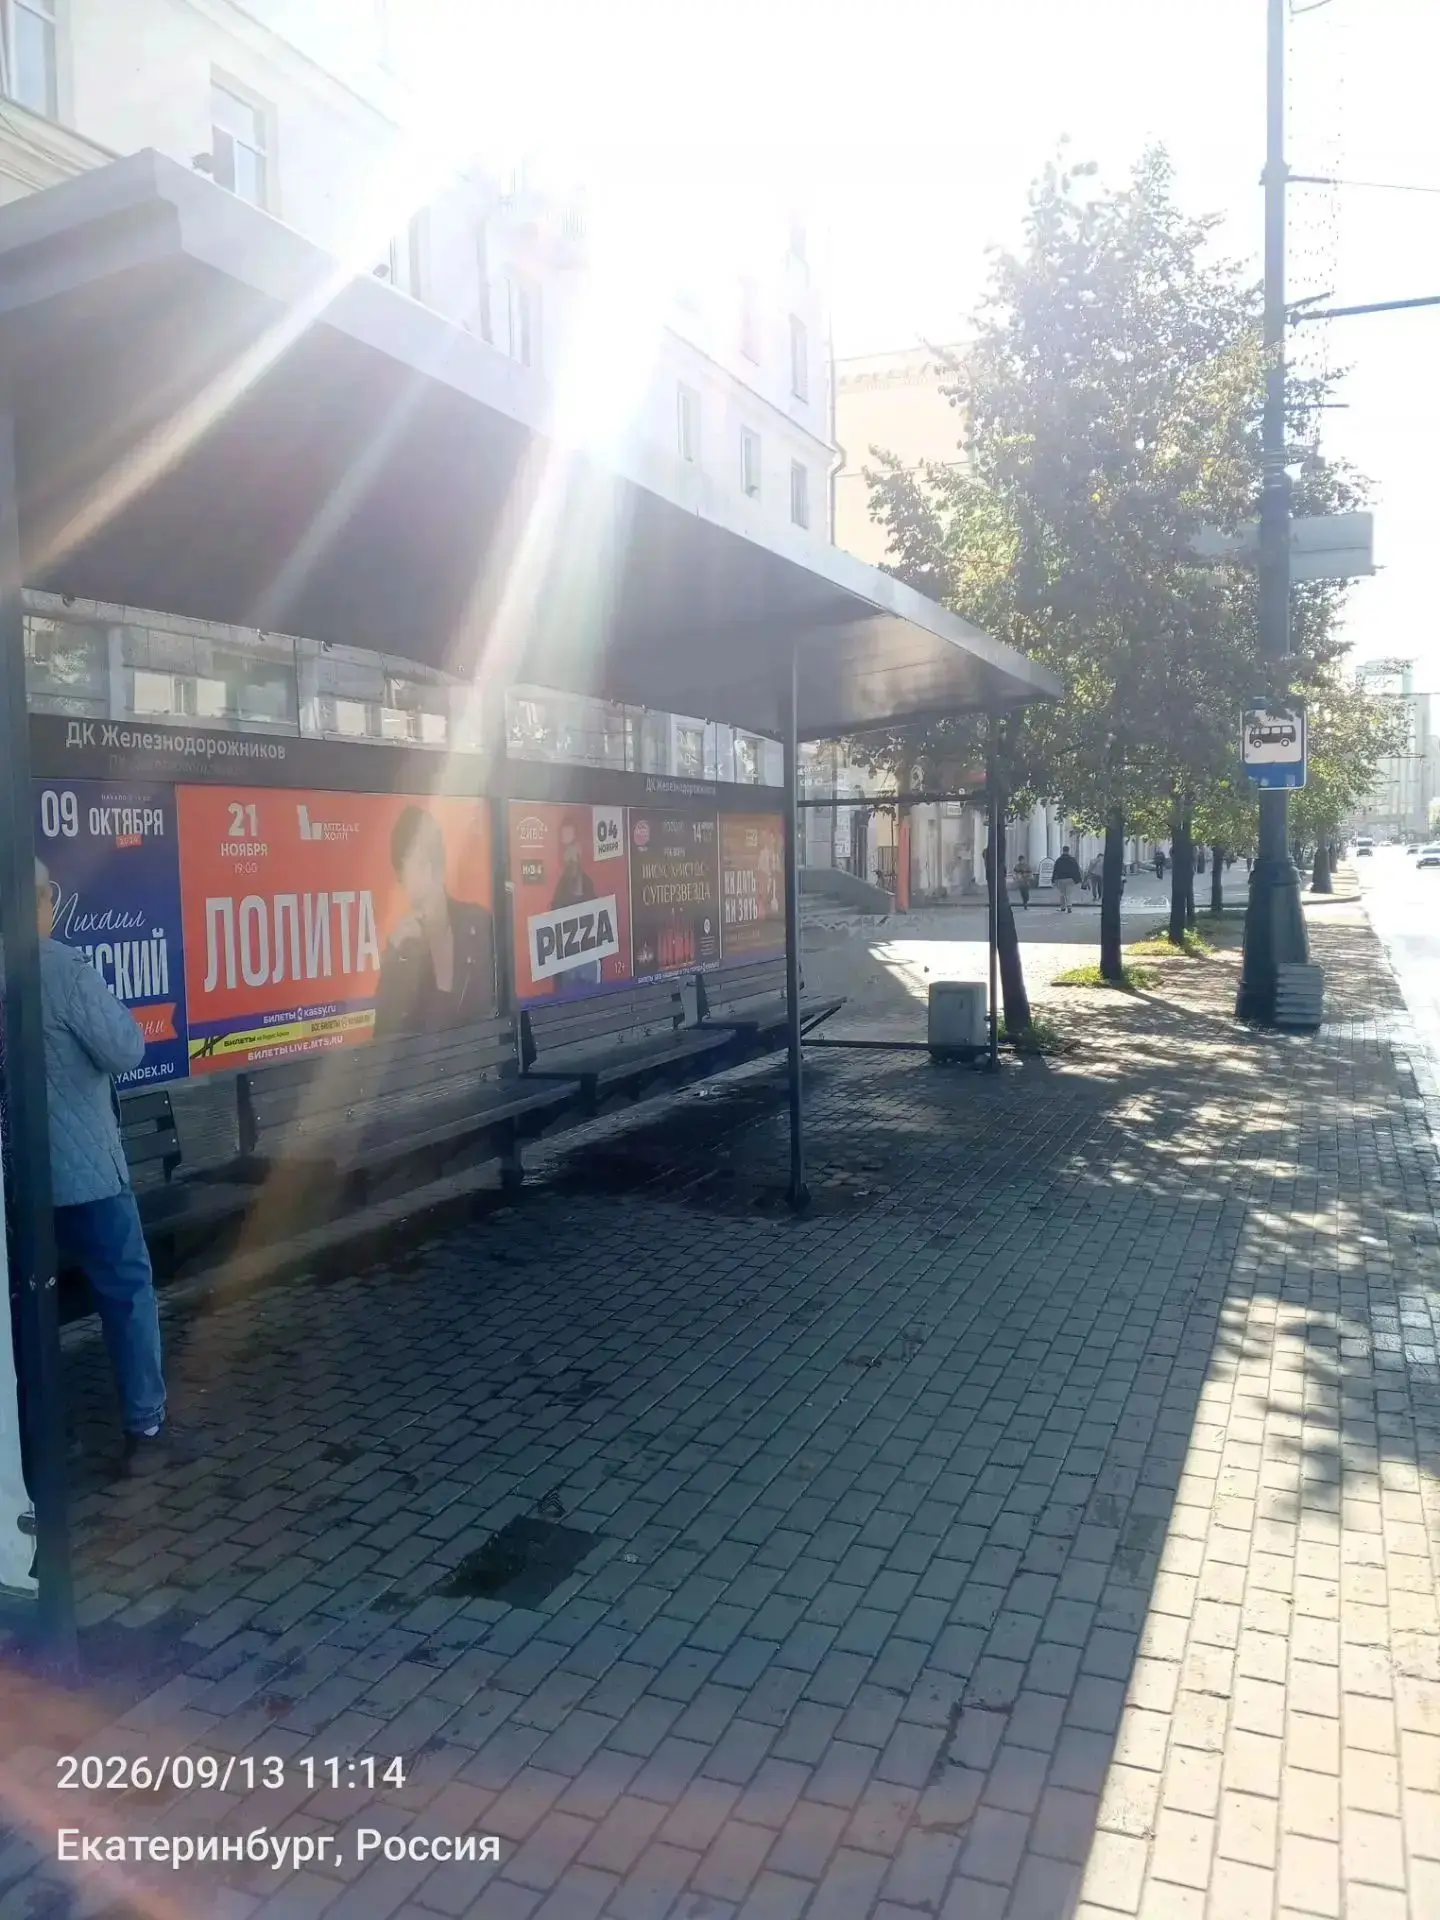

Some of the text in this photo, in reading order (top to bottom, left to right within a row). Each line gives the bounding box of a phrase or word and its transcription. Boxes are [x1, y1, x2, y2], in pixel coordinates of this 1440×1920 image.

[65, 721, 287, 760] ДК Железнодорожников
[40, 789, 79, 838] 09
[89, 806, 164, 836] ОКТЯБРЯ
[228, 802, 258, 837] 21
[597, 819, 618, 842] 04
[220, 842, 268, 857] НОЯБРЯ
[203, 889, 381, 993] ЛОЛИТА
[535, 908, 615, 967] PIZZA
[263, 1004, 337, 1024] БИЛЕТЫ kassy.ru
[223, 1035, 257, 1048] БИЛЕТЫ
[247, 1035, 343, 1062] БИЛЕТЫ LIVE.MTS.RU
